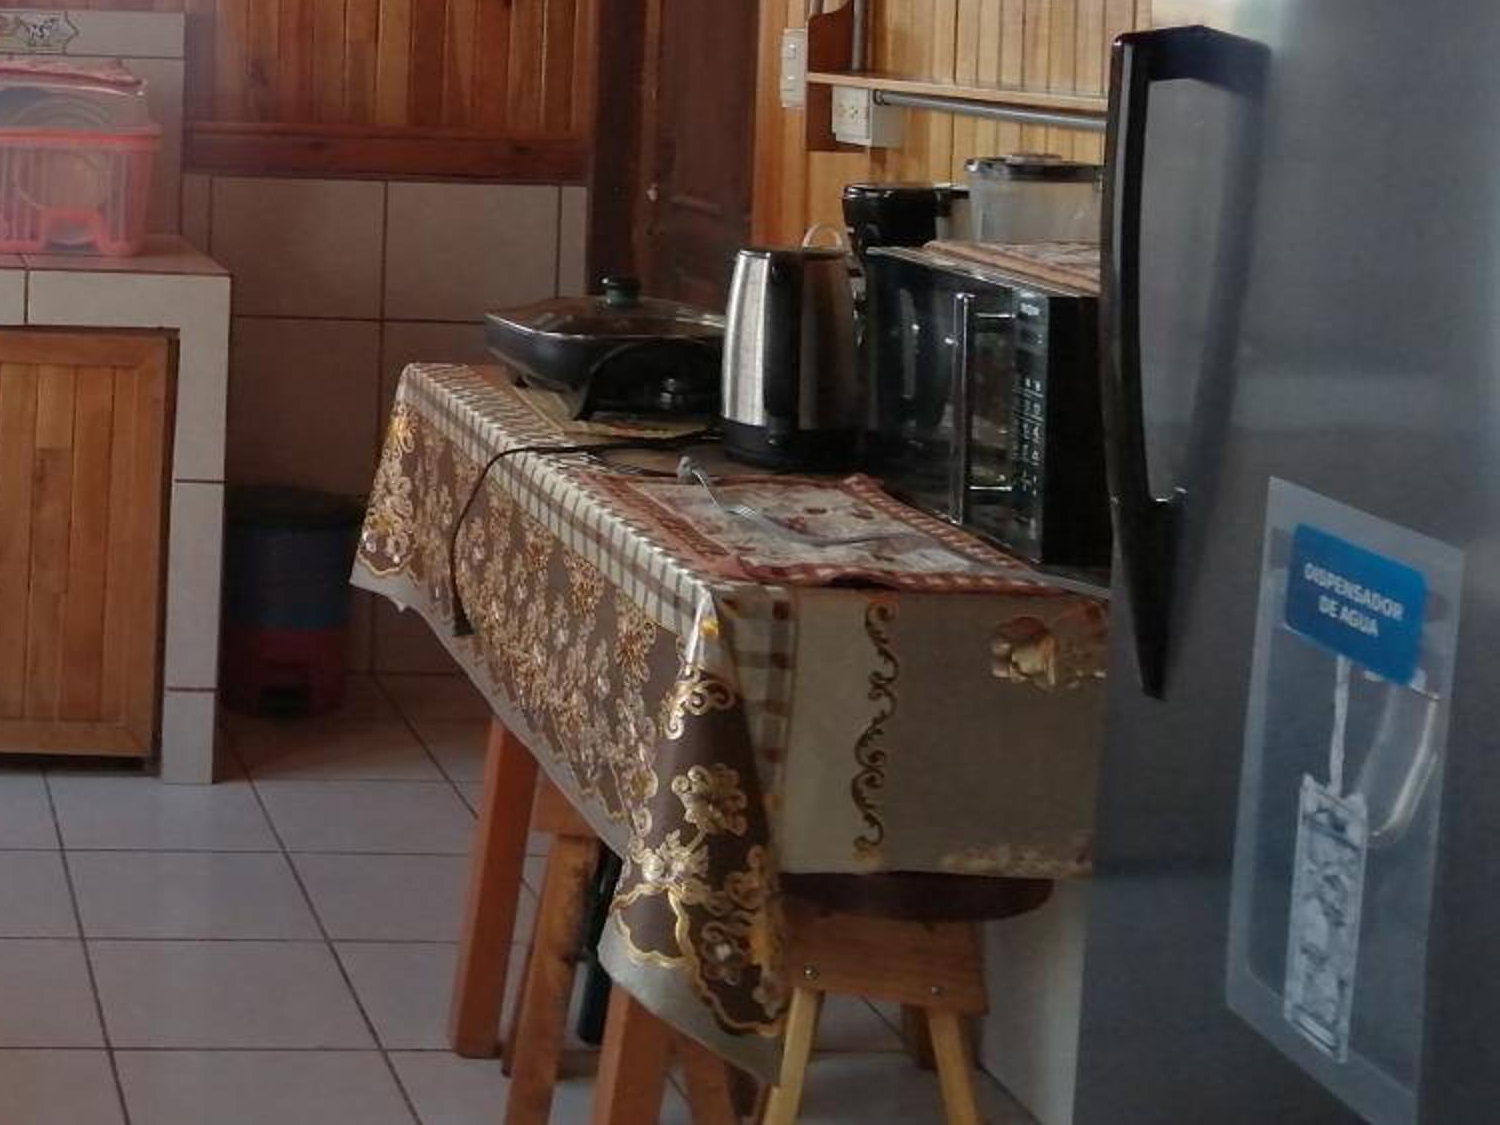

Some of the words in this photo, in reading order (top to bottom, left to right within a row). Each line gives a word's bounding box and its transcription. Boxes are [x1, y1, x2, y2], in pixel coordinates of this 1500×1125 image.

[1303, 563, 1404, 620] DISPENSADOR
[1318, 595, 1339, 618] DE
[1340, 606, 1379, 637] AGUA
